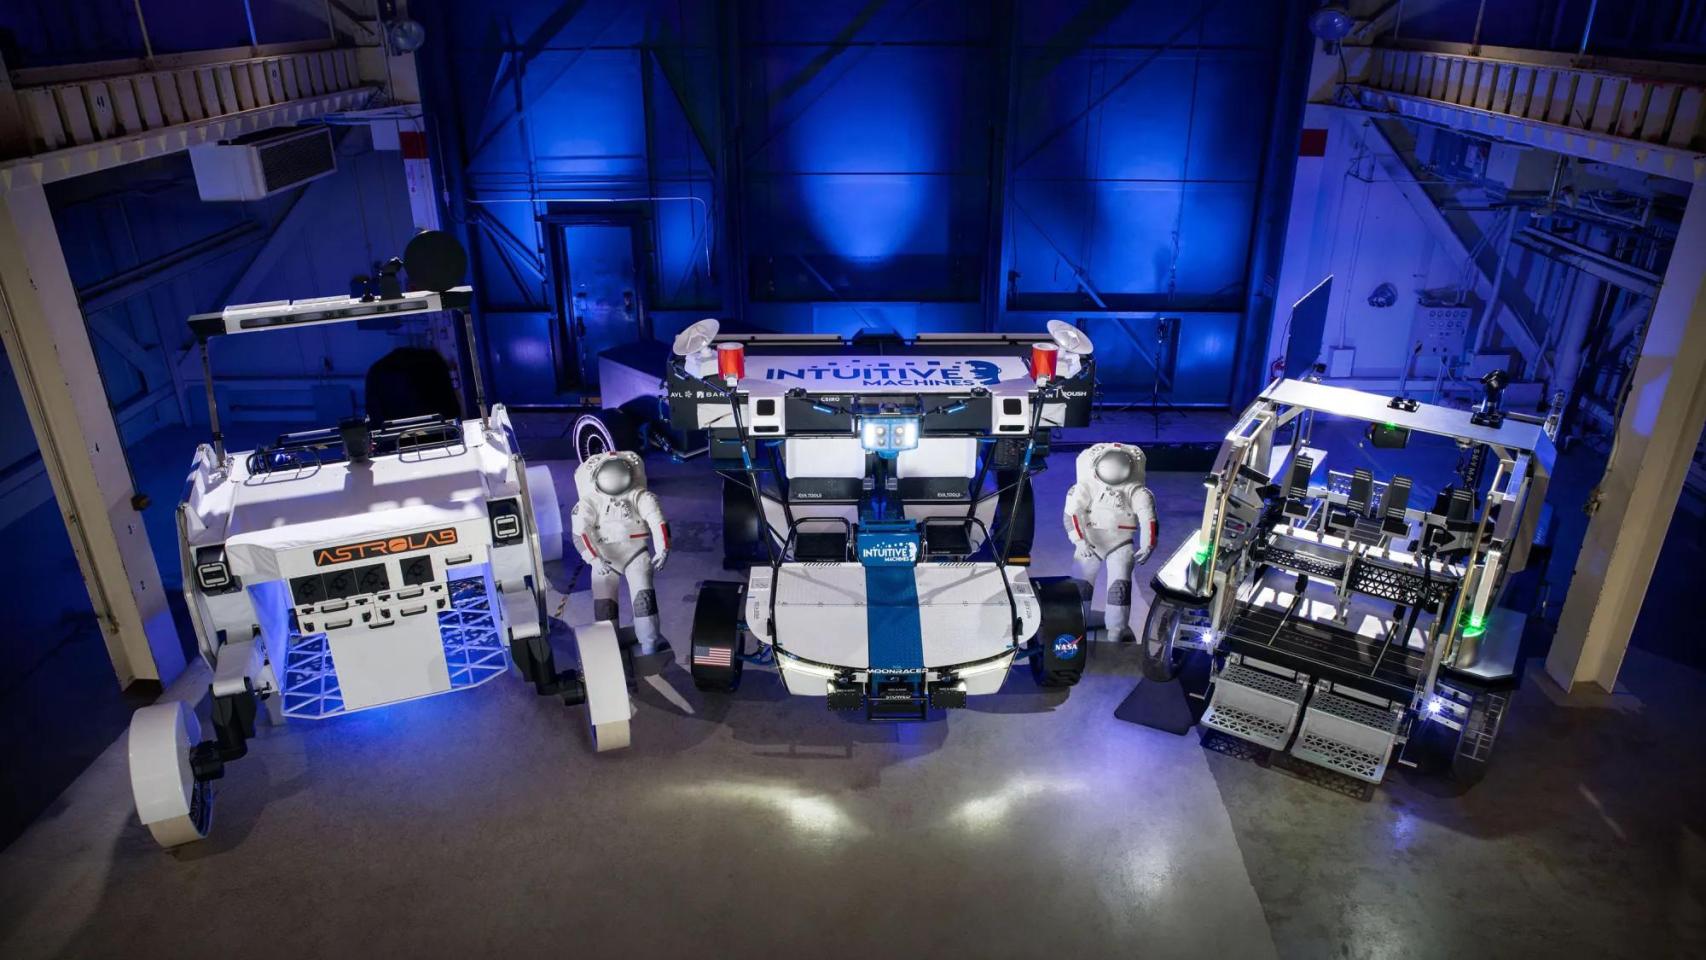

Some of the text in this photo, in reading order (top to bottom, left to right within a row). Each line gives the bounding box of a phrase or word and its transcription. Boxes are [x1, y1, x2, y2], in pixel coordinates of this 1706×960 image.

[766, 368, 960, 380] INTUITIVE
[317, 530, 456, 567] ASTROLAB
[863, 548, 907, 558] INTUITIVE
[1055, 643, 1079, 651] NASA
